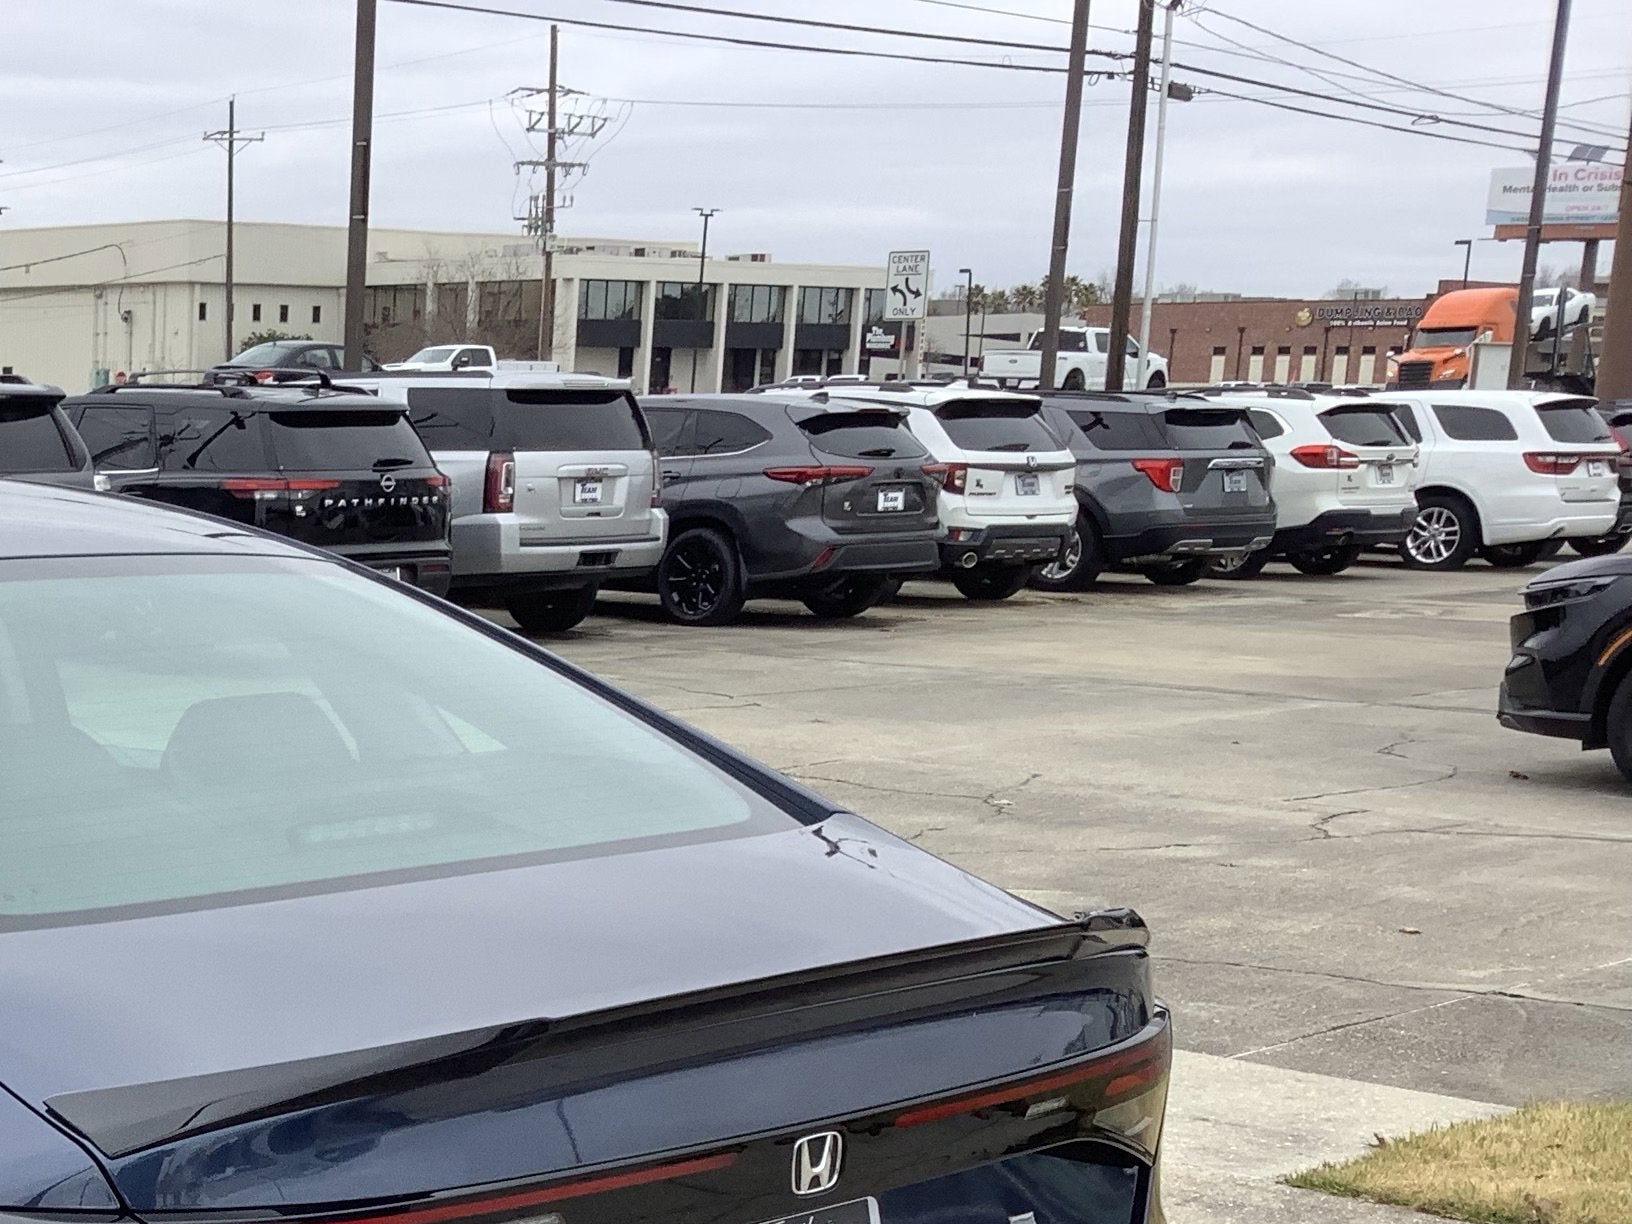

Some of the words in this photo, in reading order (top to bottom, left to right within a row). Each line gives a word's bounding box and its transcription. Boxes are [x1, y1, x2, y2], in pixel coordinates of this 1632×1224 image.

[1552, 169, 1568, 182] In
[1574, 167, 1623, 181] Crisis
[1582, 184, 1593, 193] or
[892, 254, 926, 264] CENTER
[896, 264, 920, 273] LANE
[892, 307, 916, 317] ONLY
[324, 496, 439, 508] PATHFINDER
